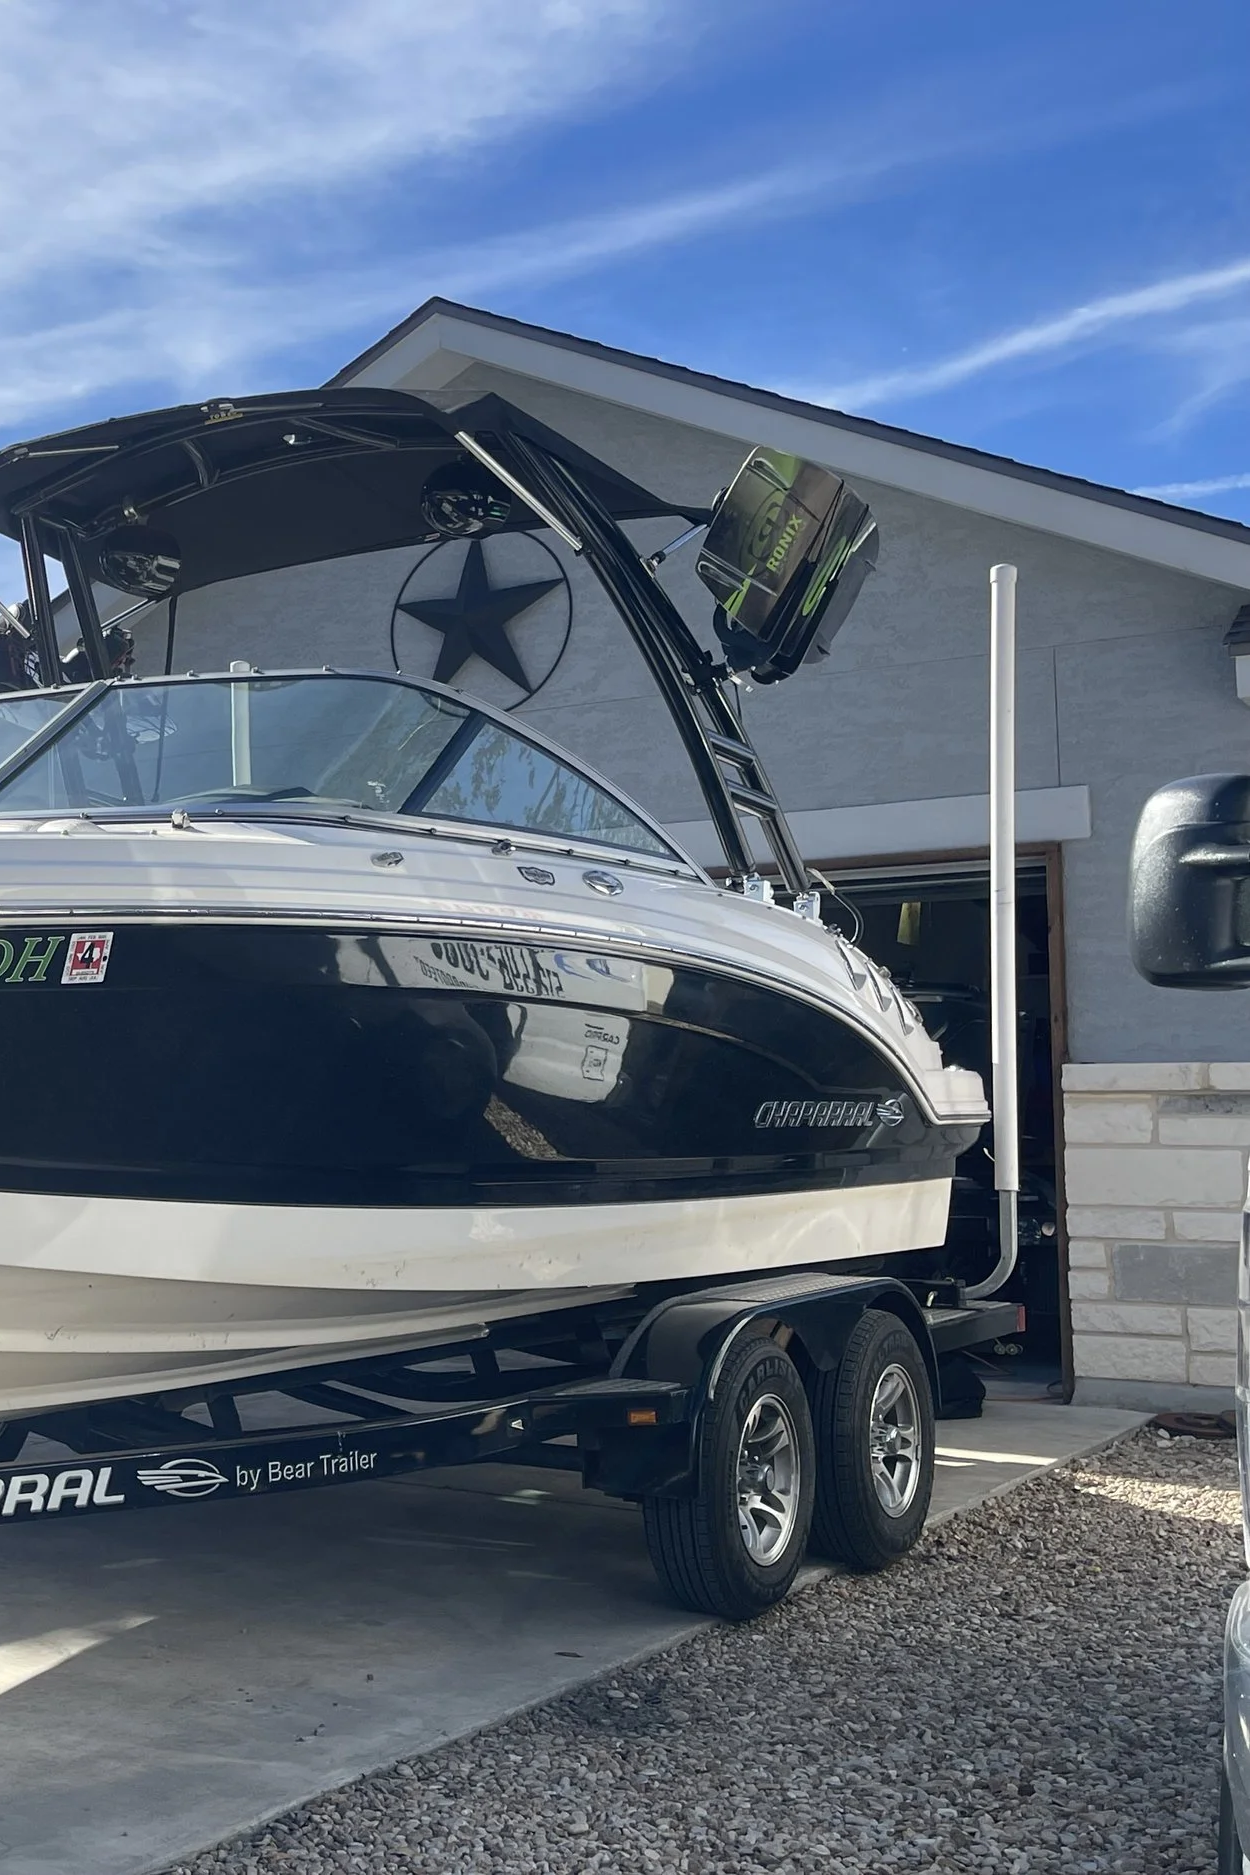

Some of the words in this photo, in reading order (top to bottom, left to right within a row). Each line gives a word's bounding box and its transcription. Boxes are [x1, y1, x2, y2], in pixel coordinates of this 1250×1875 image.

[765, 514, 803, 572] RONIX
[80, 942, 95, 969] 4
[753, 1100, 876, 1129] CHAPARRAL
[235, 1464, 260, 1493] by
[267, 1459, 315, 1484] Bear
[320, 1450, 378, 1475] Trailer
